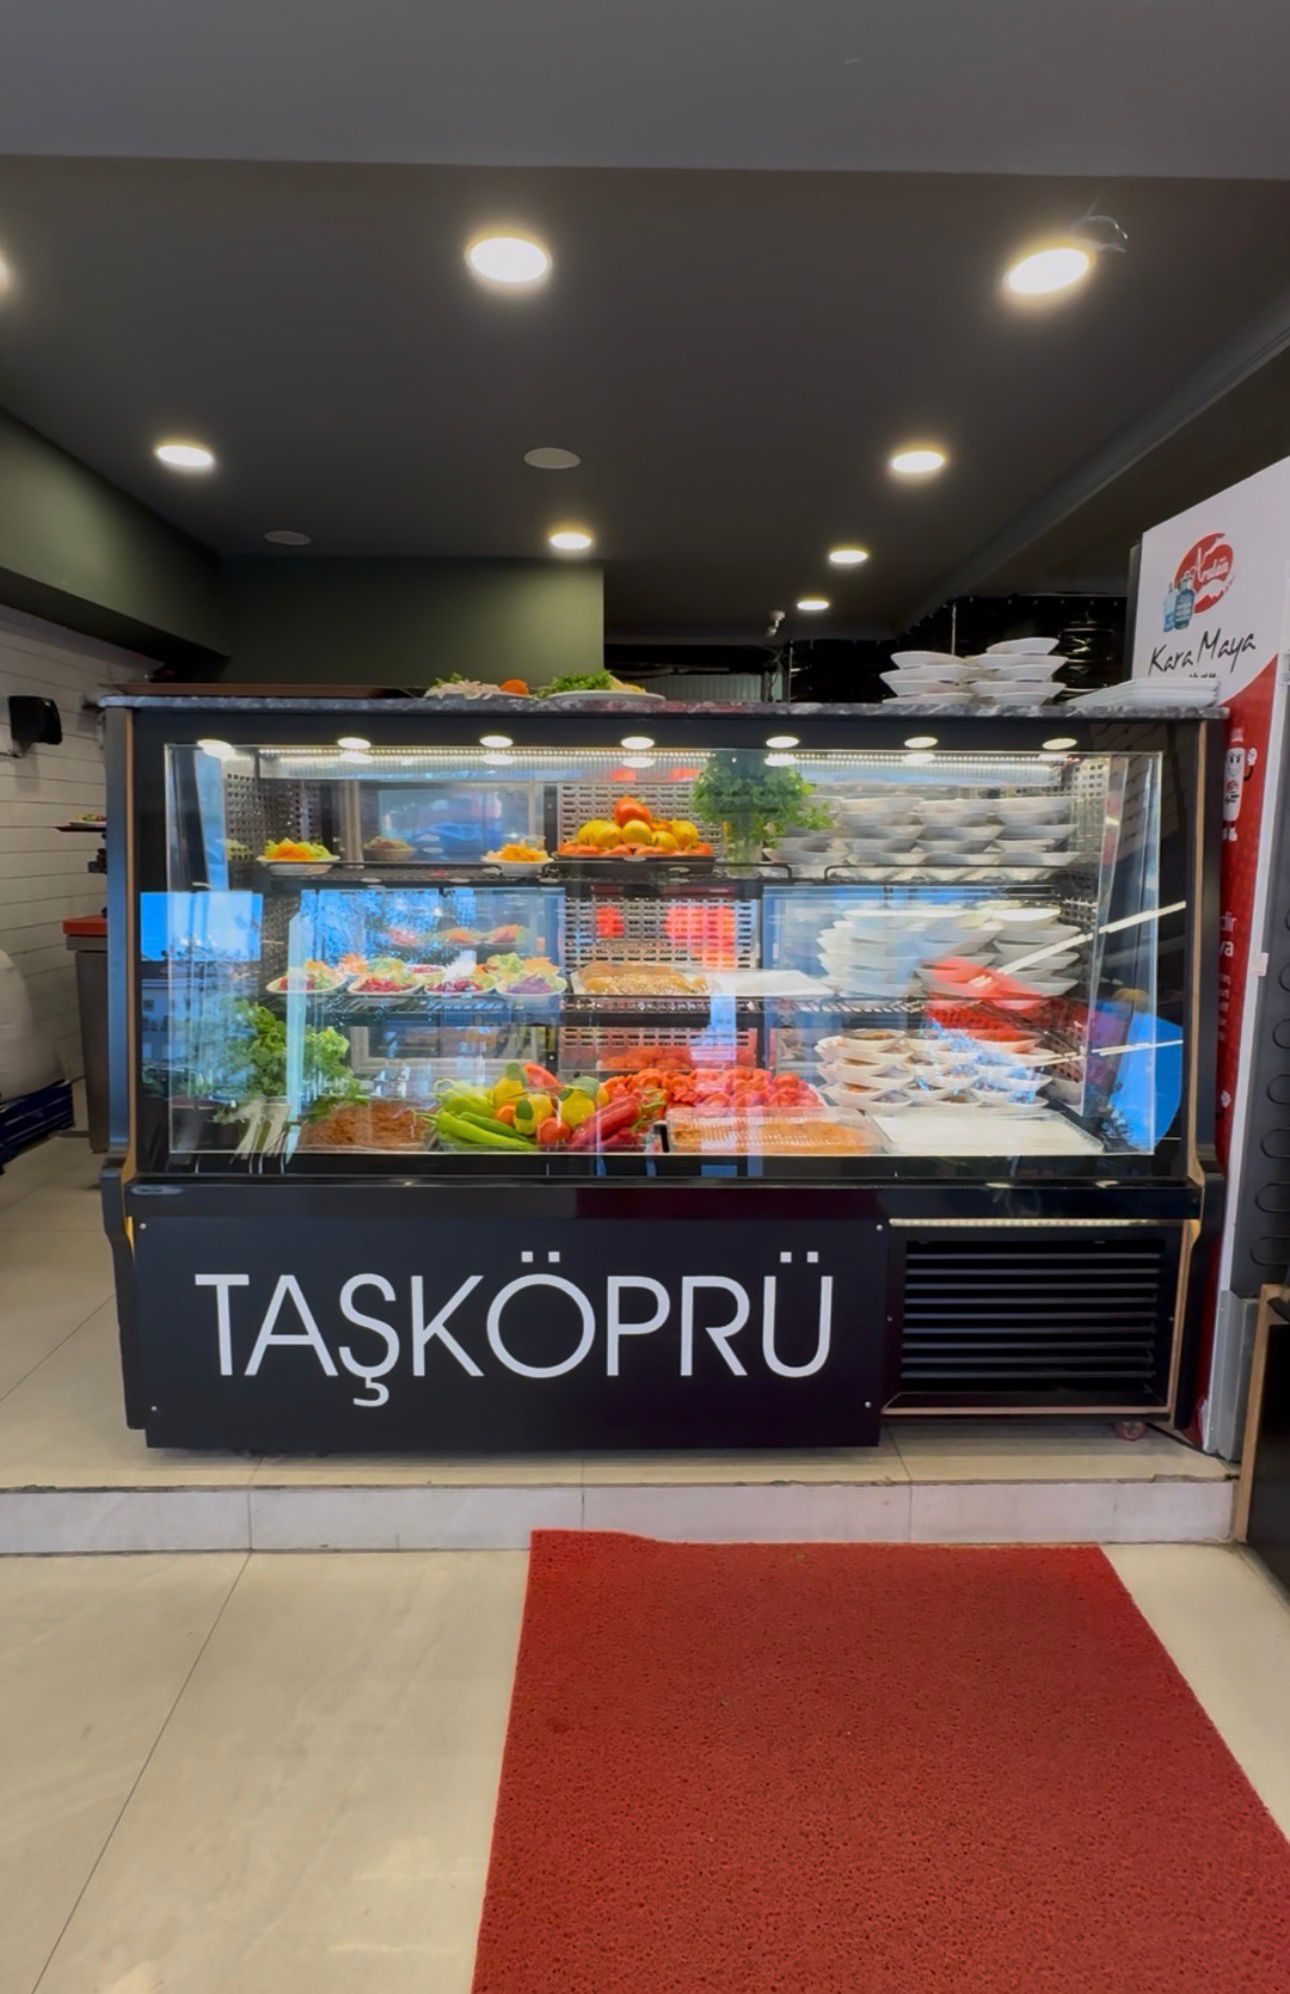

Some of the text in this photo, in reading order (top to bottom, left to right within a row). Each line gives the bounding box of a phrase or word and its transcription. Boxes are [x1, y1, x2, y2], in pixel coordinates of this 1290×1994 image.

[1148, 627, 1256, 677] Kara Maya
[195, 1251, 833, 1407] TAŞKÖPRÜ
